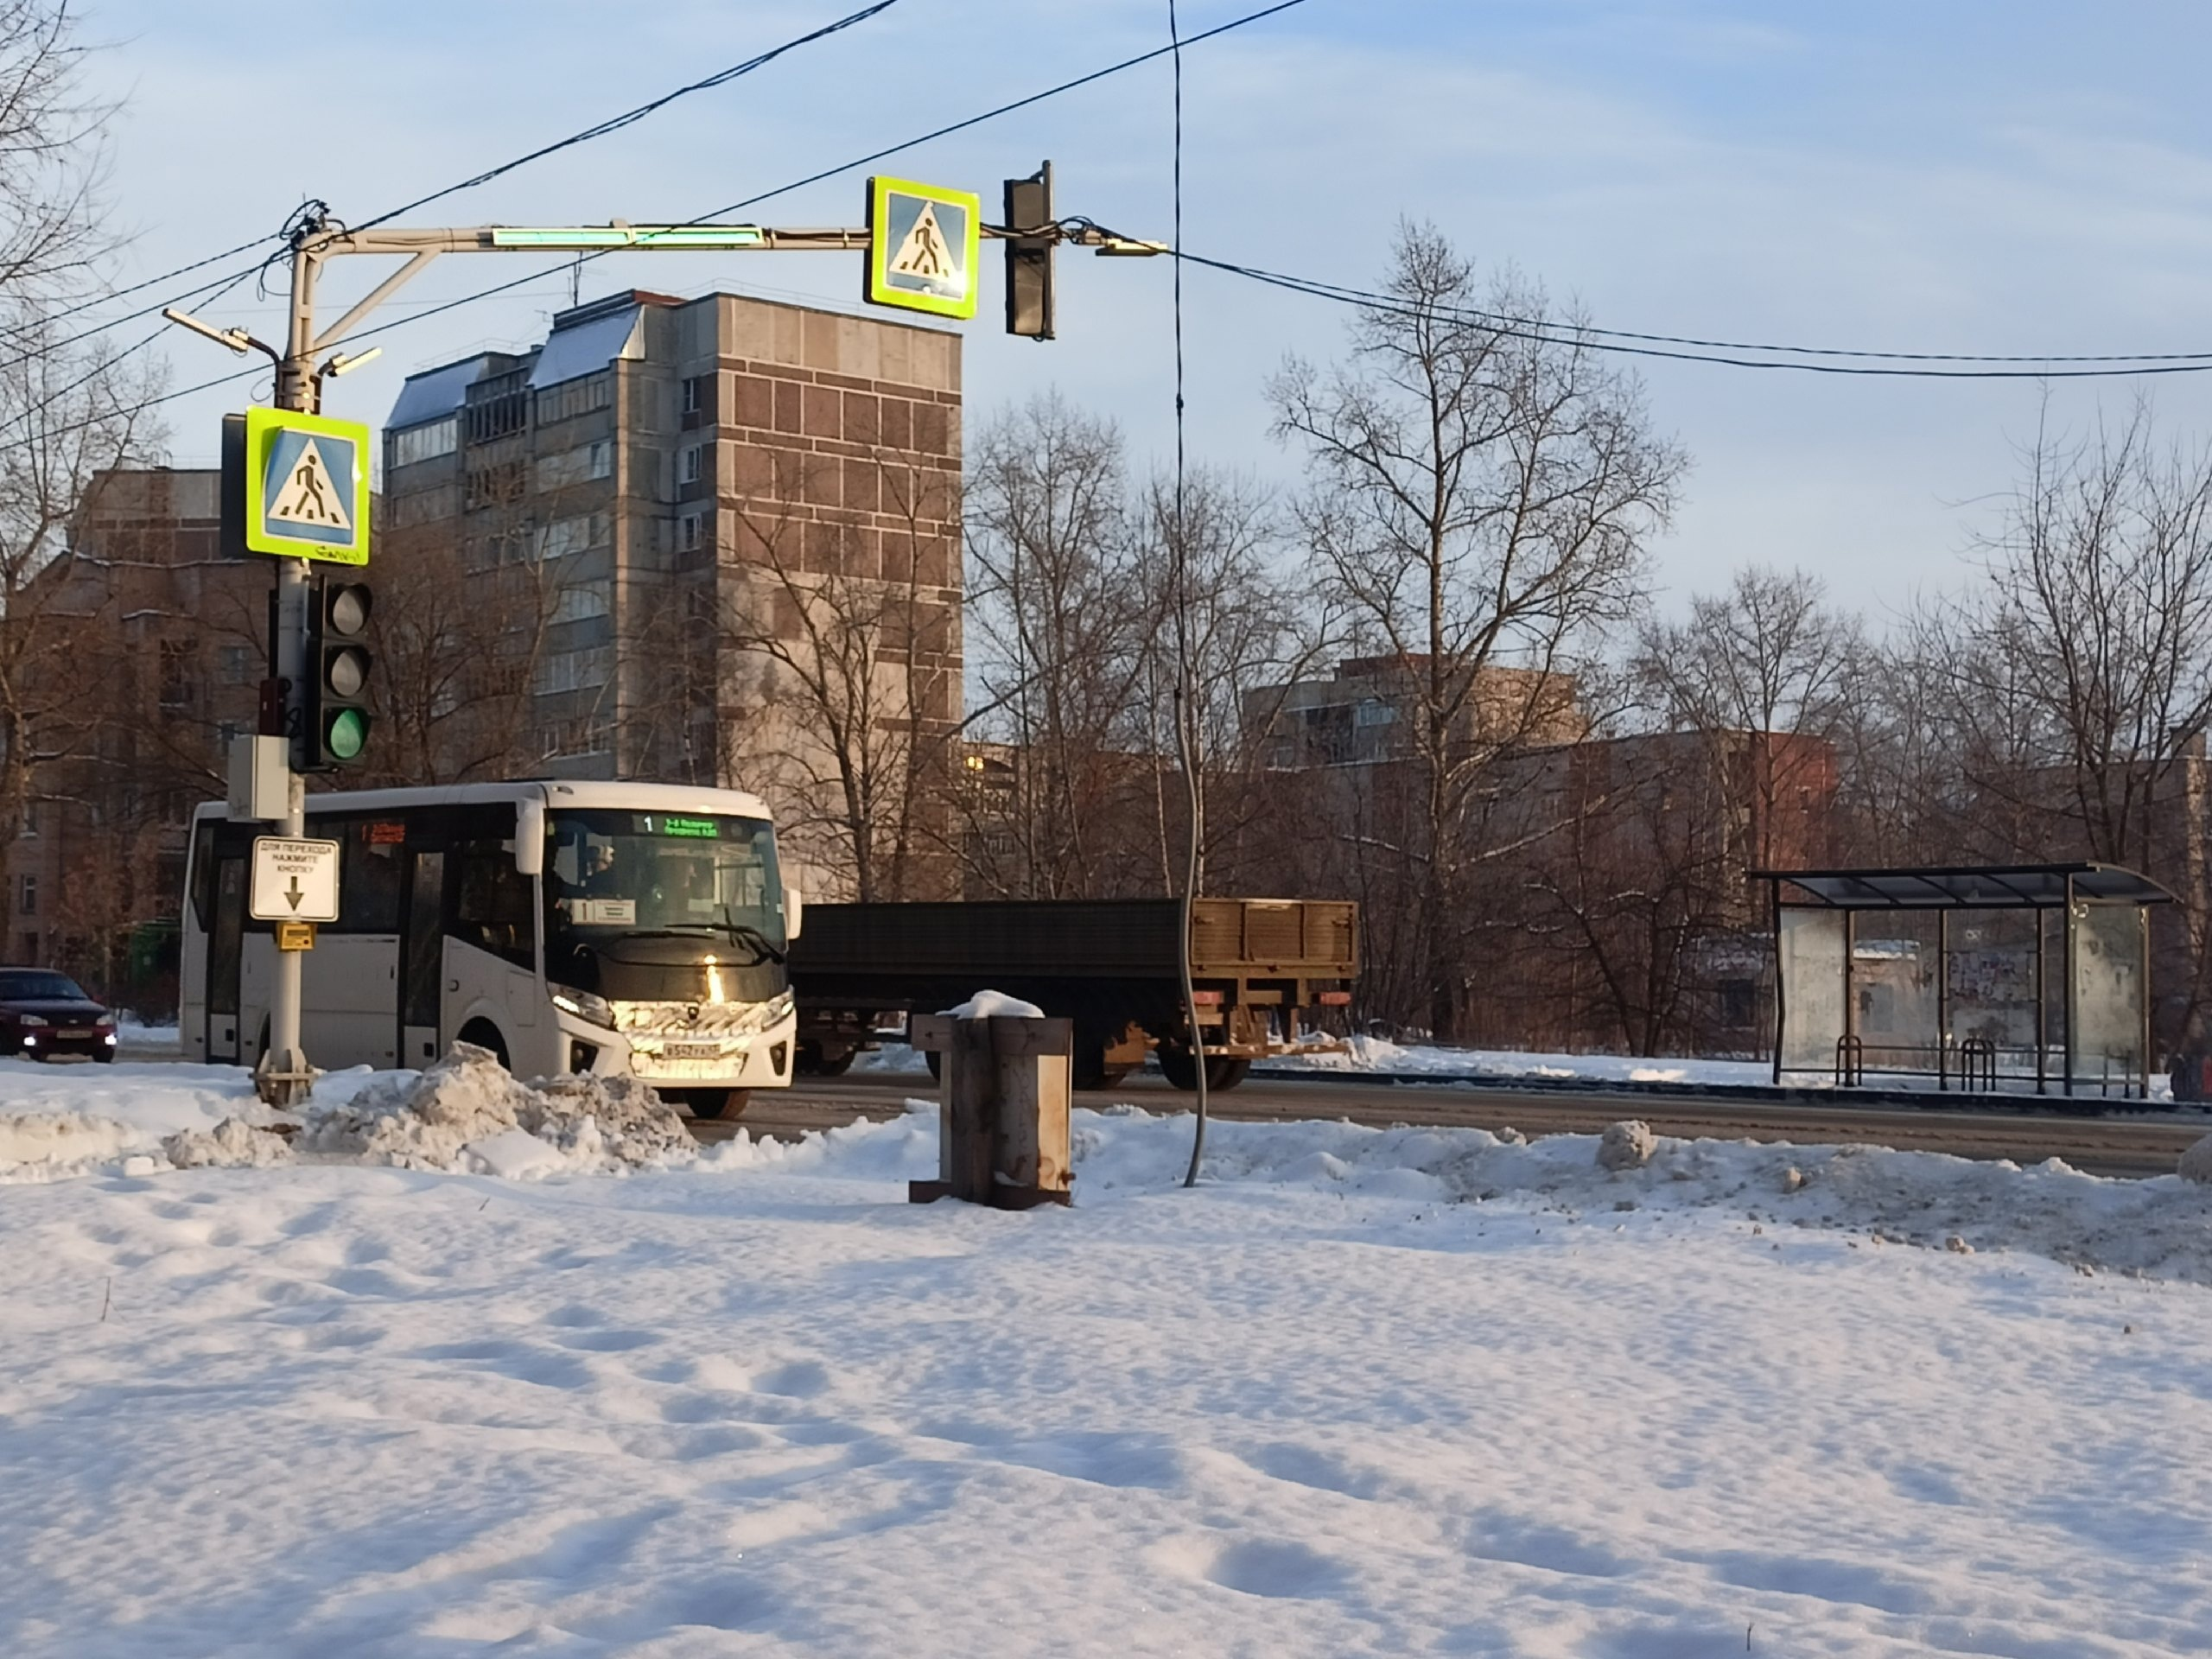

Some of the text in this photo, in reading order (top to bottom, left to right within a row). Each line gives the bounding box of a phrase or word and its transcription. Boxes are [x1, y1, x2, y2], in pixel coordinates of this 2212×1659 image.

[644, 816, 653, 832] 1
[261, 842, 332, 855] ДЛЯ ПЕРЕХОДА
[272, 854, 319, 863] НАЖМИТЕ
